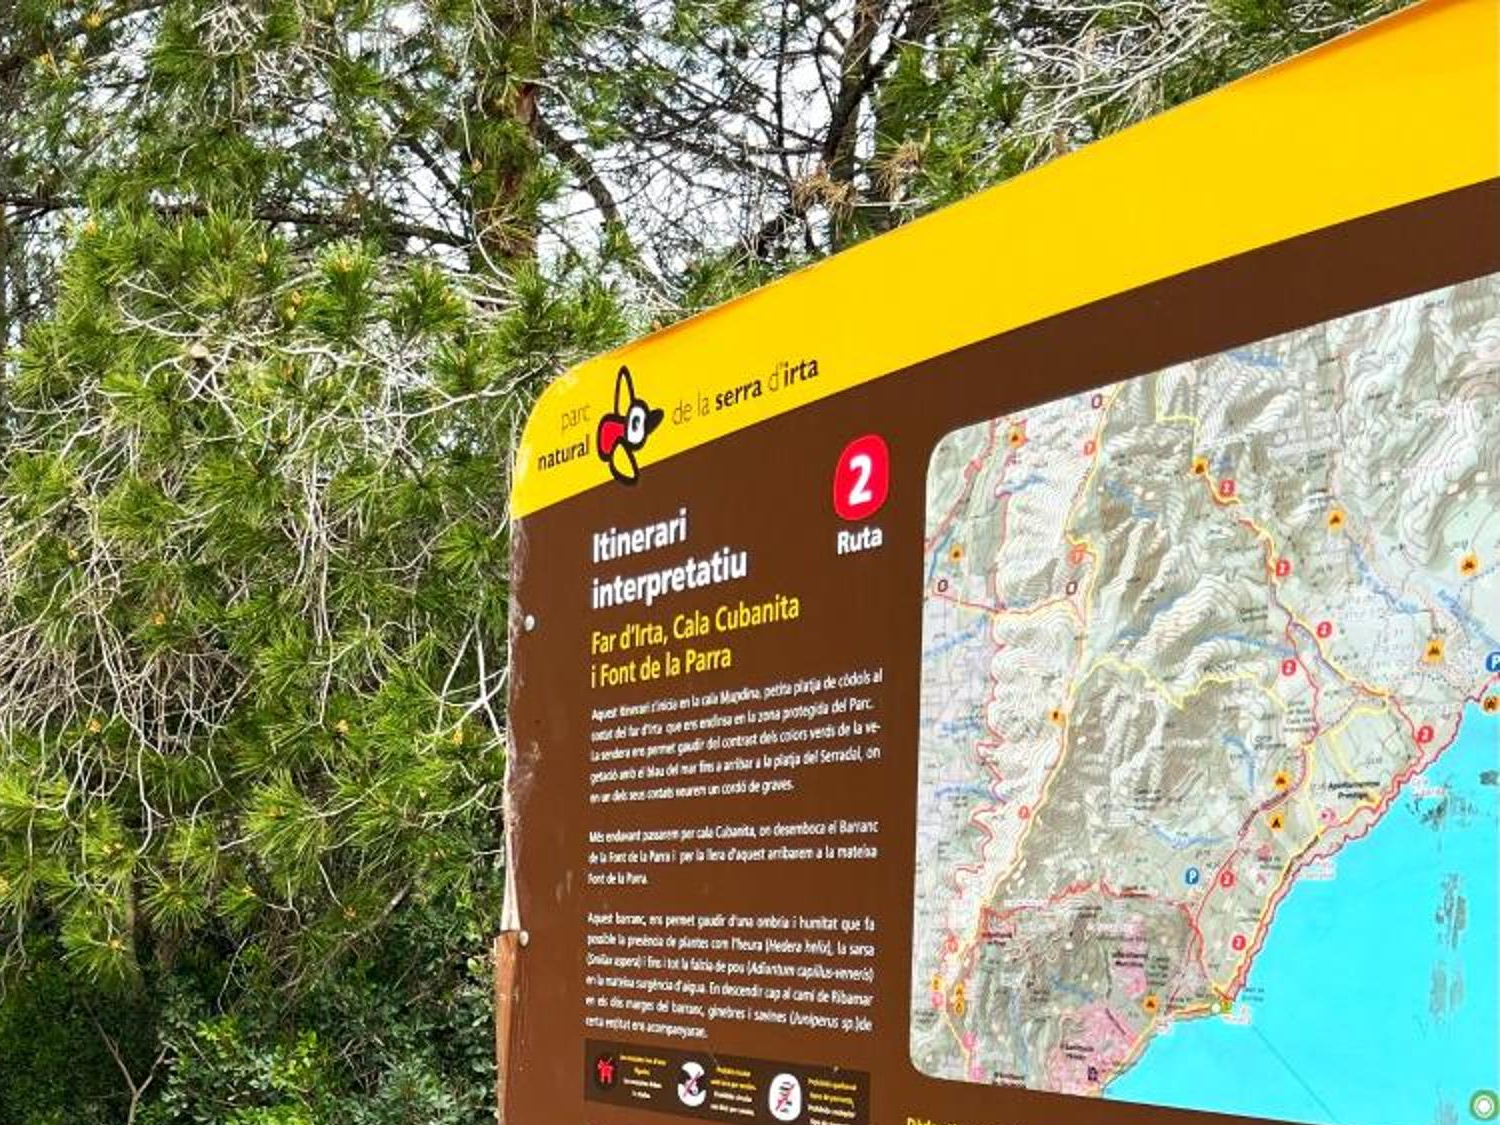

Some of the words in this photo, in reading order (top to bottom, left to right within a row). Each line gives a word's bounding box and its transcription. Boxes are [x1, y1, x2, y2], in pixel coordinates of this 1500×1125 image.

[671, 399, 693, 426] de
[697, 391, 710, 416] la
[715, 380, 763, 410] serra
[768, 359, 819, 391] d'irta
[561, 404, 591, 434] parc
[538, 434, 590, 470] natural
[847, 453, 873, 507] 2
[593, 508, 686, 562] Itinerari
[837, 527, 883, 554] Ruta
[593, 548, 747, 608] interpretatiu
[592, 631, 617, 654] Far
[619, 623, 668, 649] d'Irta,
[673, 610, 710, 639] Cala
[715, 595, 799, 631] Cubanita
[591, 664, 596, 688] i
[600, 661, 636, 686] Font
[640, 655, 661, 680] de
[665, 651, 681, 677] la
[685, 648, 731, 673] Parra
[823, 675, 836, 689] de
[872, 668, 883, 683] al
[831, 698, 847, 713] del
[803, 750, 819, 765] del
[865, 747, 881, 759] on
[748, 780, 760, 793] de
[773, 822, 826, 836] desemboca
[827, 820, 837, 834] el
[839, 820, 879, 833] Barranc
[816, 848, 823, 859] a
[825, 845, 835, 859] la
[837, 844, 878, 858] mateixa
[799, 916, 838, 930] humitat
[841, 919, 860, 933] que
[864, 917, 875, 931] fa
[816, 989, 830, 1003] de
